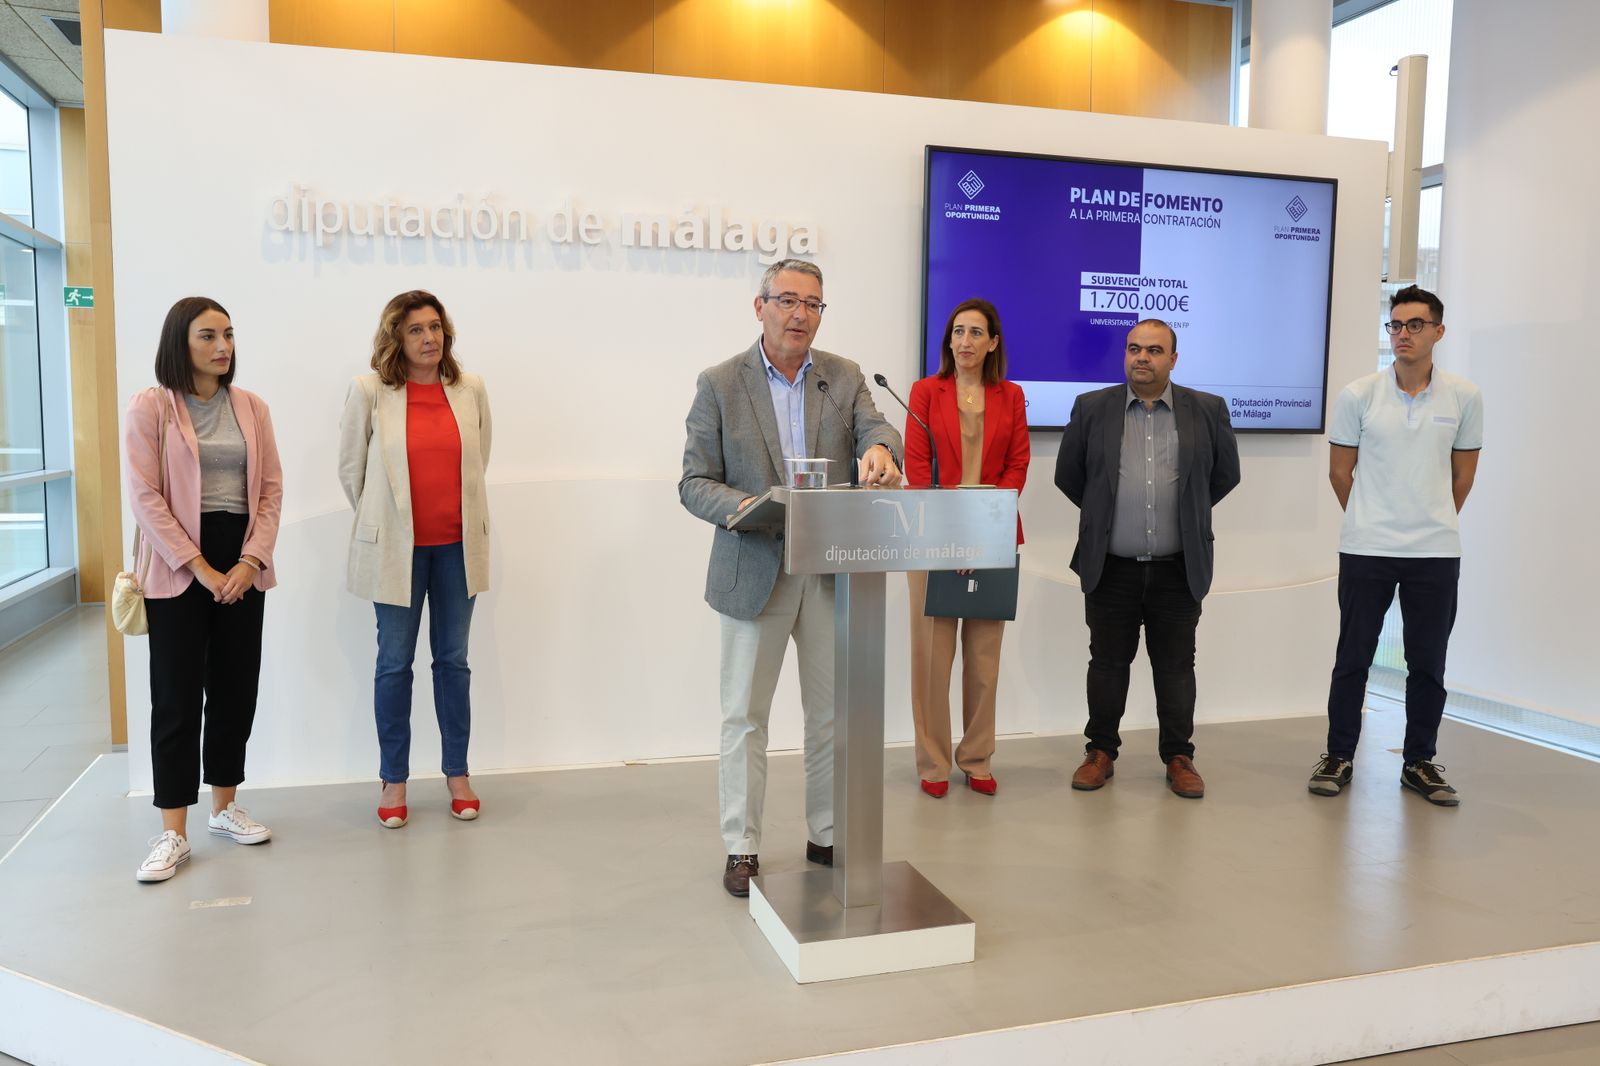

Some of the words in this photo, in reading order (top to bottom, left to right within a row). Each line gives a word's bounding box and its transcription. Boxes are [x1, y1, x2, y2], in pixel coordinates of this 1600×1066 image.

[1070, 186, 1115, 206] PLAN
[1119, 190, 1141, 208] DE
[1144, 193, 1224, 213] FOMENTO
[944, 202, 963, 211] PLAN
[964, 204, 1001, 213] PRIMERA
[945, 211, 1000, 221] OPORTUNIDAD
[1069, 208, 1078, 220] A
[1079, 208, 1093, 221] LA
[1096, 209, 1141, 224] PRIMERA
[1143, 213, 1221, 229] CONTRATACIÓN
[267, 182, 528, 248] diputación
[548, 194, 602, 245] de
[621, 203, 819, 265] málaga
[1290, 226, 1321, 235] PRIMERA
[1274, 233, 1320, 242] OPORTUNIDAD
[1091, 275, 1156, 288] SUBVENCIÓN
[1158, 279, 1188, 289] TOTAL
[1090, 291, 1190, 312] 1.700.000€
[1090, 318, 1137, 327] UNIVERSITARIOS
[1173, 321, 1182, 329] EN
[1231, 398, 1273, 408] Diputación
[1274, 398, 1312, 408] Provincial
[1231, 409, 1241, 418] de
[1243, 409, 1272, 420] Málaga
[825, 544, 899, 564] diputación
[903, 544, 921, 560] de
